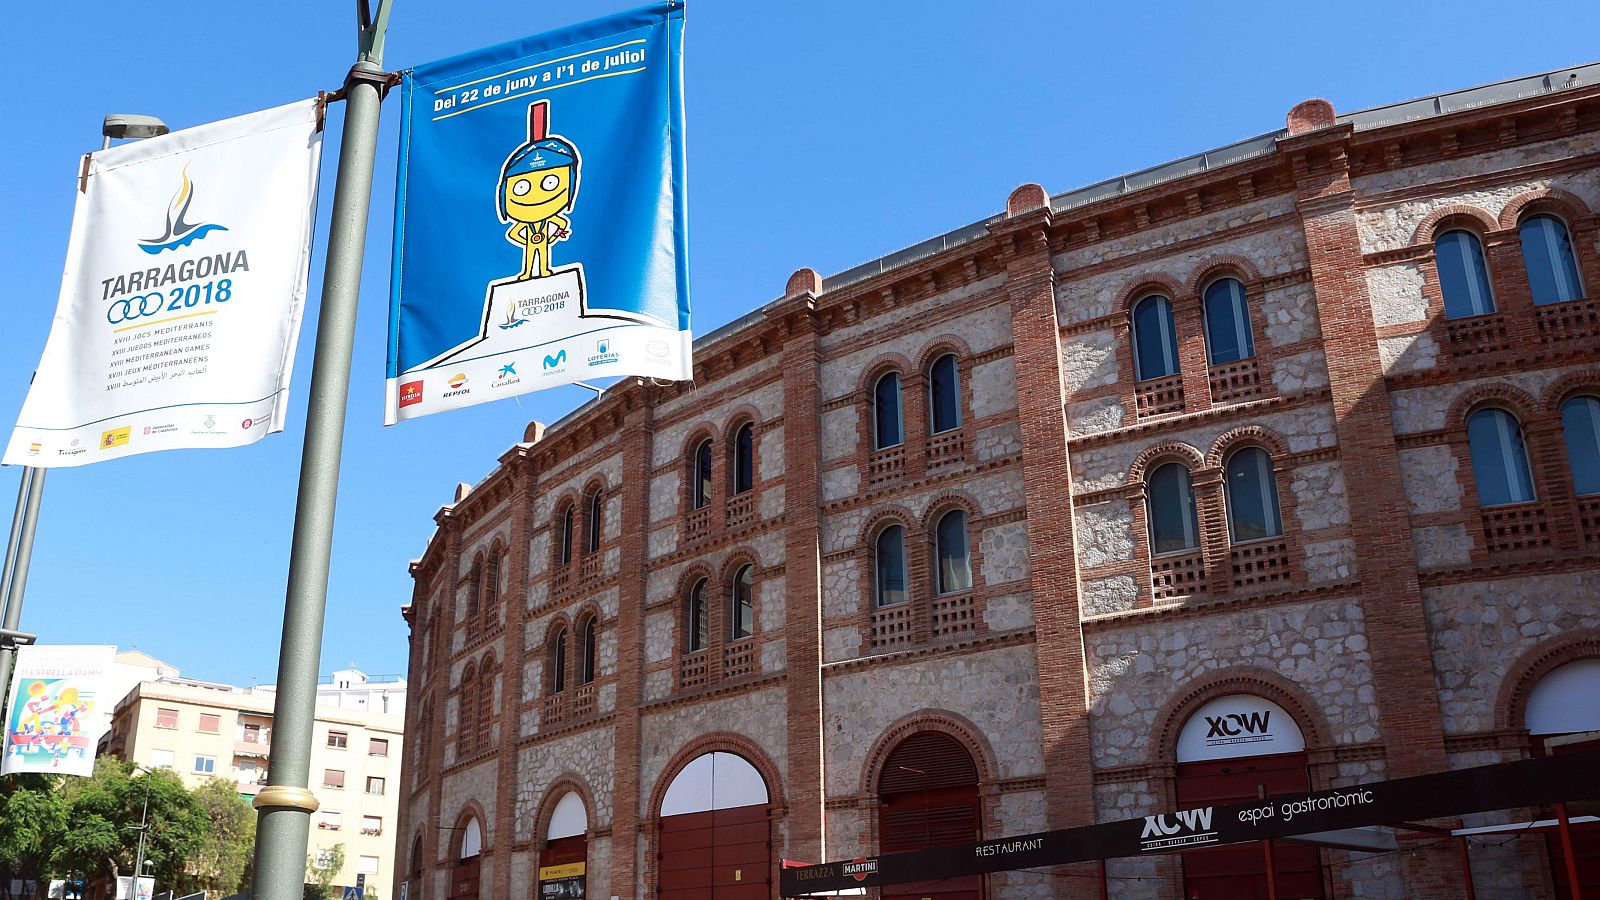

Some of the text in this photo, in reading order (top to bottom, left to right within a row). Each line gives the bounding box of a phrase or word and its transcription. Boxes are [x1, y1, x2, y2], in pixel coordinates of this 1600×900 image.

[434, 94, 456, 112] Del
[460, 88, 479, 104] 22
[483, 83, 501, 98] de
[505, 73, 538, 95] juny
[542, 70, 551, 82] a
[581, 59, 600, 74] de
[604, 48, 645, 70] juliol
[101, 249, 250, 301] TARRAGONA
[166, 278, 232, 311] 2018
[518, 290, 570, 308] TARRAGONA
[543, 300, 565, 313] 2018
[113, 320, 213, 345] XVIII JOCS MEDITERRANIS
[109, 343, 210, 368] XVIII MEDITERRANEAN GAMES
[111, 347, 126, 357] XVIII
[126, 341, 152, 353] JUEGOS
[107, 370, 123, 380] XVIII
[123, 366, 141, 376] JEUX
[541, 368, 566, 377] movistar
[106, 382, 121, 392] XVIII
[491, 378, 521, 388] CaixaBank
[443, 388, 471, 398] REPSOL
[1238, 788, 1374, 826] espai gastronòmic
[975, 838, 1043, 857] RESTAURANT
[796, 867, 834, 880] TERRAZZA
[844, 861, 876, 874] MARTINI
